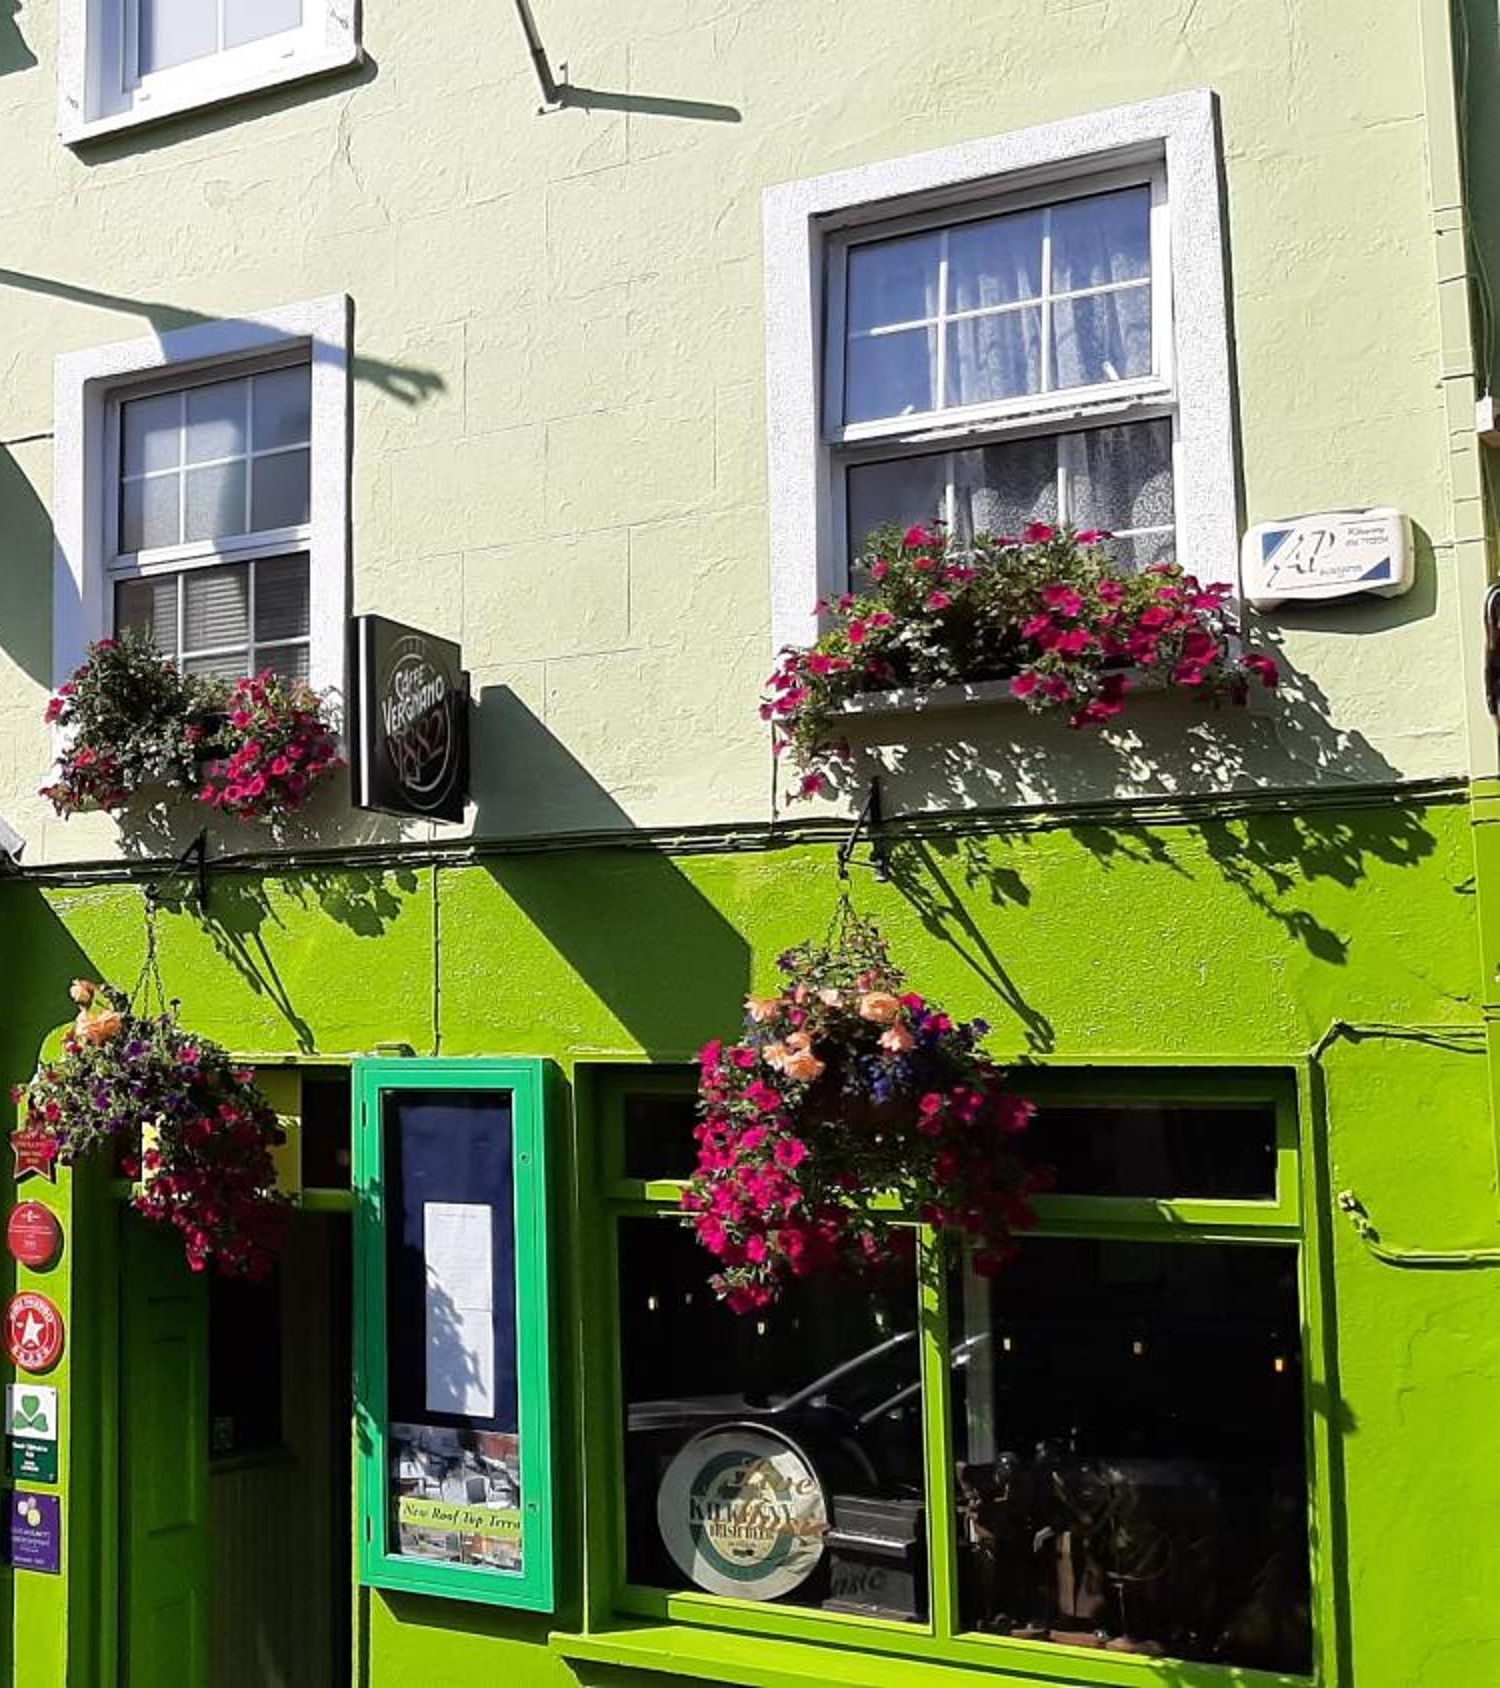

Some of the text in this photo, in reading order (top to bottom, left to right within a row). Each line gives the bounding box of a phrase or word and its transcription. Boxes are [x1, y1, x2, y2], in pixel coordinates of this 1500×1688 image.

[403, 1504, 430, 1518] New
[431, 1507, 460, 1525] Roof
[463, 1511, 483, 1529] Top
